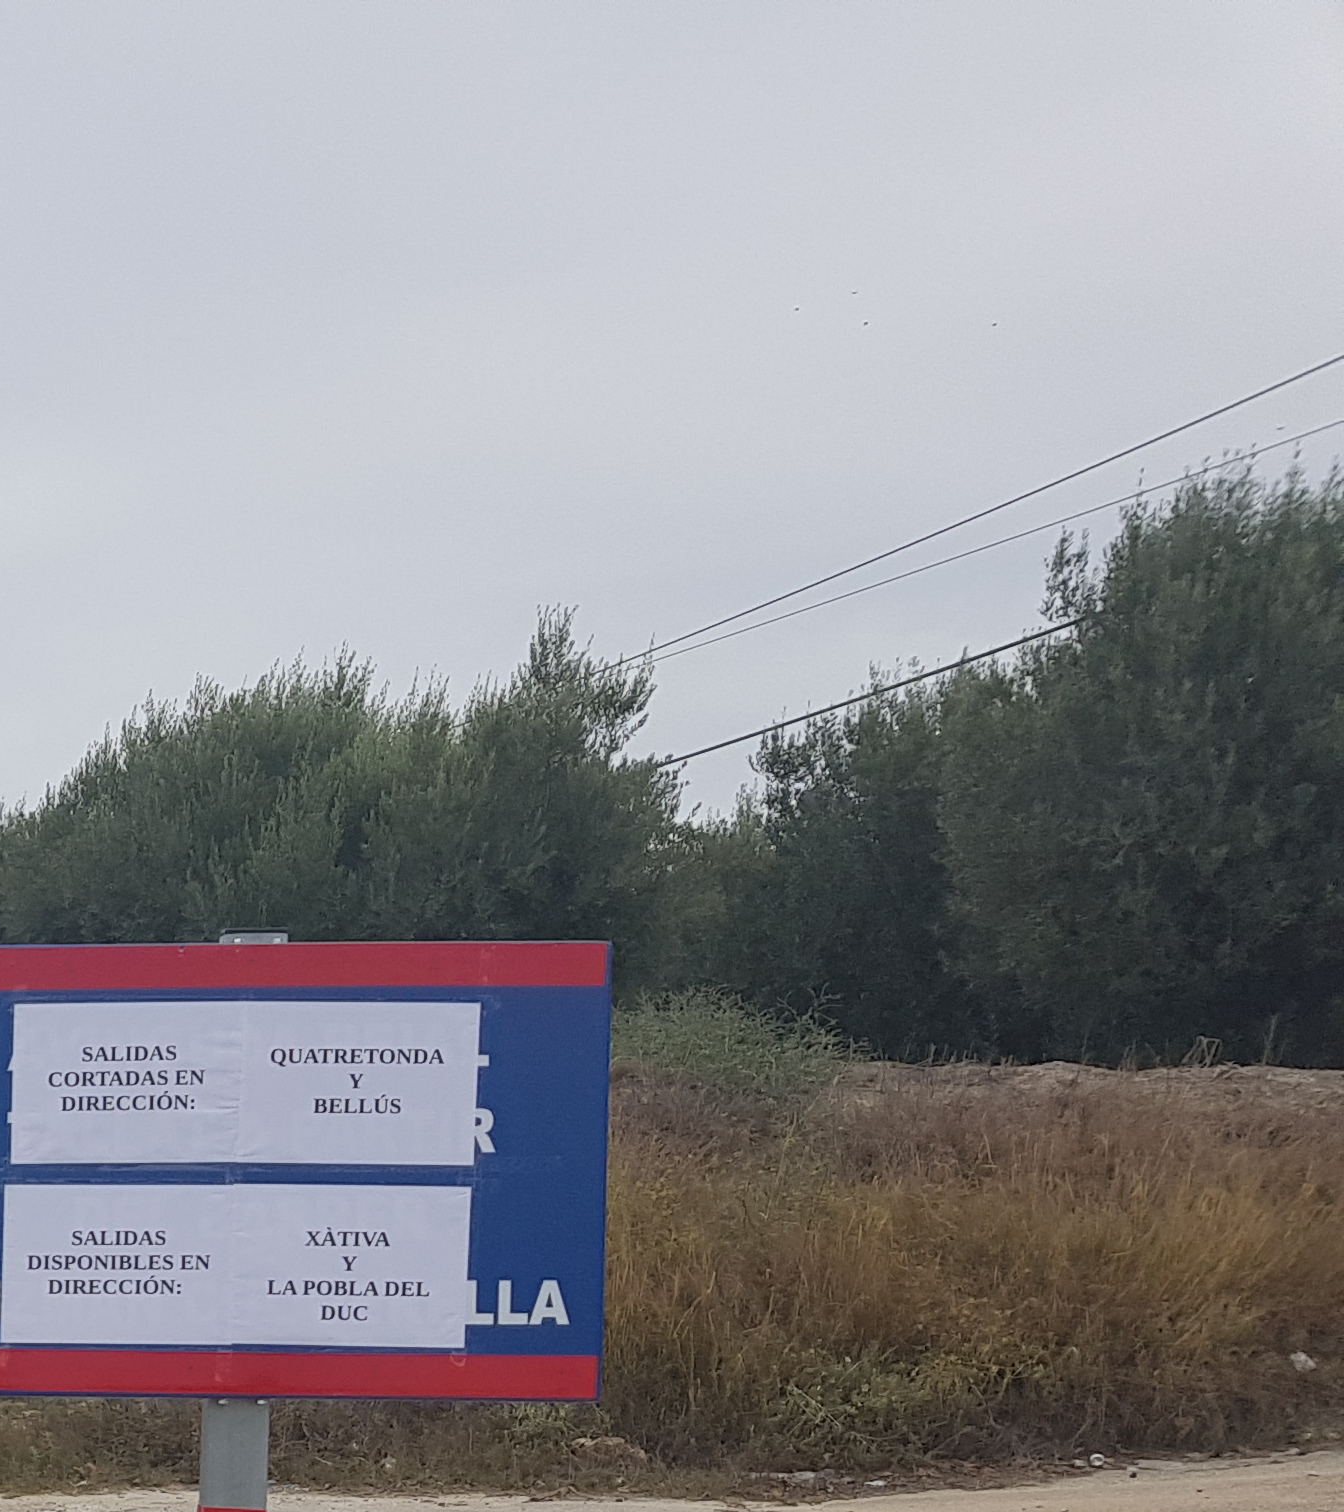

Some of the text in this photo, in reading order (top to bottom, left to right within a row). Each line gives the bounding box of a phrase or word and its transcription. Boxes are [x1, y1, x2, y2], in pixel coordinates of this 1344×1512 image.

[81, 1045, 178, 1063] SALIDAS
[269, 1047, 445, 1068] QUATRETONDA
[48, 1069, 206, 1088] CORTADAS EN
[349, 1073, 365, 1089] Y
[60, 1090, 196, 1112] DIRECCIÓN:
[312, 1094, 402, 1114] BELLÚS
[70, 1230, 167, 1246] SALIDAS
[304, 1226, 391, 1247] XÀTIVA
[26, 1254, 211, 1271] DISPONIBLES EN
[342, 1256, 358, 1272] Y
[47, 1274, 183, 1295] DIRECCIÓN:
[267, 1279, 430, 1297] LA POBLA DEL
[320, 1305, 369, 1321] DUC
